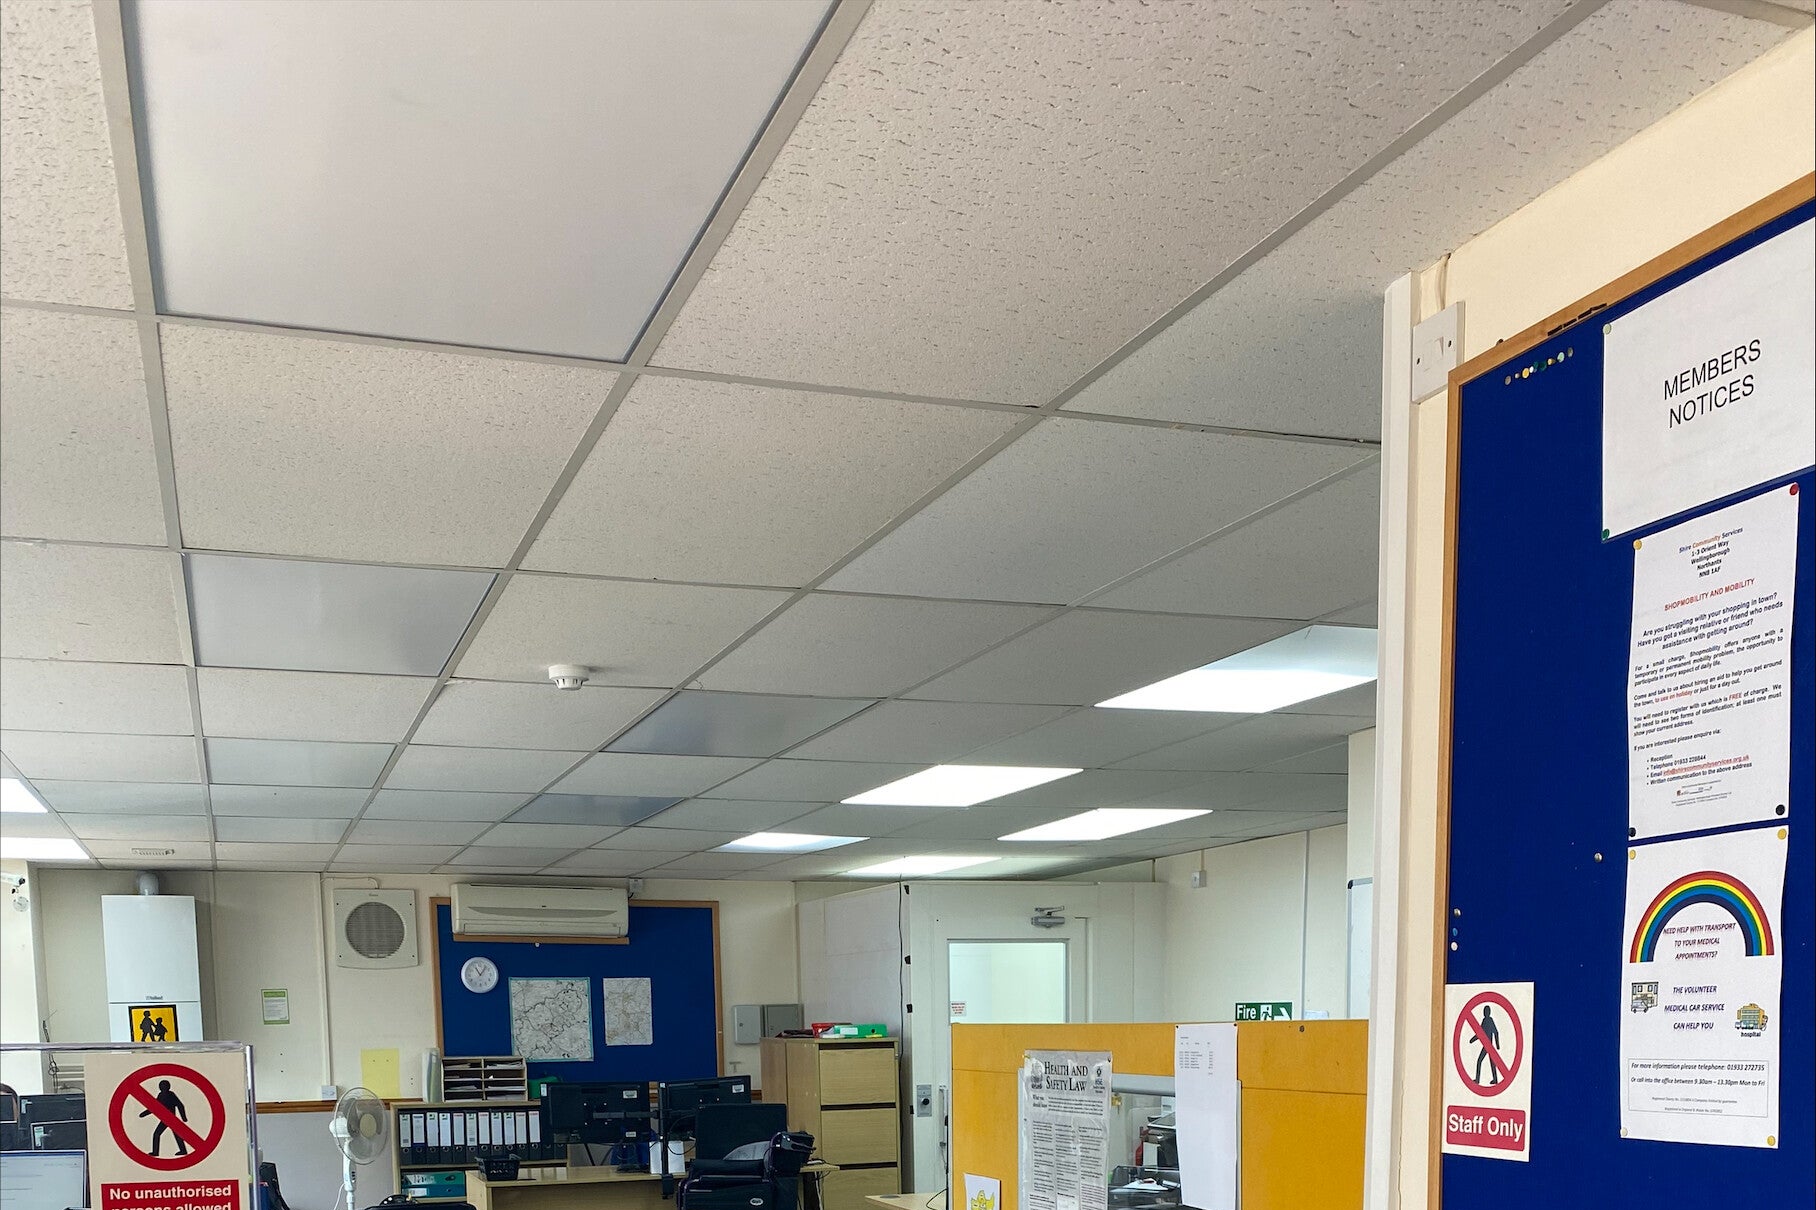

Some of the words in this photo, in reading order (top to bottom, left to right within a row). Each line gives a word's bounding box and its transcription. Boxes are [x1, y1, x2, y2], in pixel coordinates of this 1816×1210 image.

[1664, 339, 1761, 400] MEMBERS
[1669, 374, 1754, 428] NOTICES
[1665, 592, 1709, 611] SHOPMOBILITY
[1710, 588, 1723, 597] AND
[1725, 578, 1755, 593] MOBILITY
[1652, 636, 1662, 644] you
[1664, 632, 1673, 641] got
[1679, 626, 1698, 635] visiting
[1700, 620, 1721, 630] relative
[1731, 610, 1748, 620] friend
[1750, 607, 1762, 615] who
[1764, 601, 1783, 611] needs
[1654, 627, 1663, 635] you
[1665, 618, 1693, 630] struggling
[1695, 614, 1706, 622] with
[1708, 610, 1721, 620] your
[1723, 602, 1750, 614] shopping
[1758, 592, 1777, 603] town?
[1662, 637, 1692, 649] assistance
[1693, 633, 1705, 641] with
[1707, 627, 1727, 638] getting
[1729, 618, 1753, 631] around?
[1705, 923, 1736, 931] TRANSPORT
[1675, 951, 1718, 959] APPOINTMENTS?
[1237, 1005, 1256, 1019] Fire
[1449, 1114, 1483, 1134] Staff
[1488, 1116, 1523, 1142] Only
[110, 1188, 130, 1200] No
[135, 1185, 231, 1199] unauthorised
